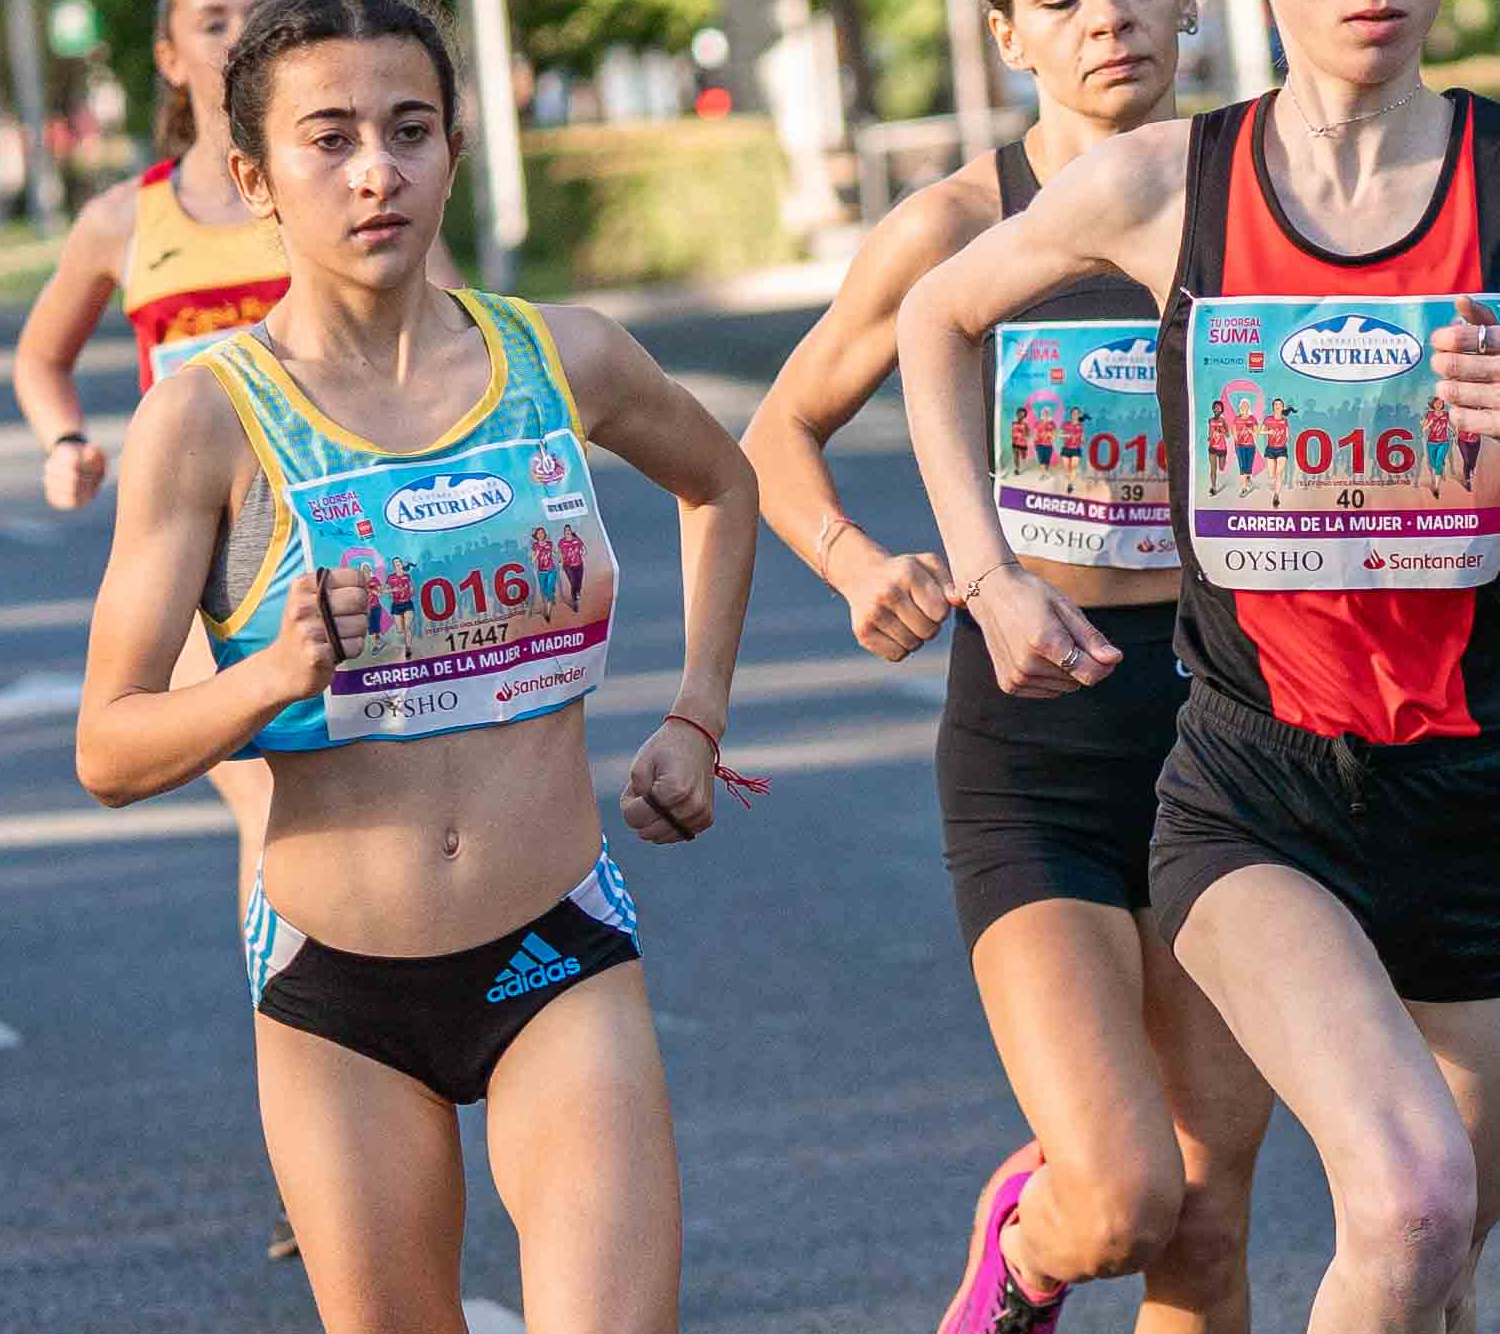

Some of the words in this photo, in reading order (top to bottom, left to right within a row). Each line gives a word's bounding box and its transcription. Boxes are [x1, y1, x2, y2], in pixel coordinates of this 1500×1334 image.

[1224, 317, 1261, 327] DORSAL
[1209, 328, 1260, 343] SUMA
[1291, 339, 1413, 364] ASTURIANA
[1295, 428, 1415, 475] 016
[1120, 484, 1144, 501] 39
[1336, 488, 1365, 508] 40
[312, 501, 363, 523] SUMA
[398, 489, 506, 524] ASTURIANA
[1025, 494, 1086, 517] CARRERA
[1088, 504, 1107, 520] DE
[1108, 507, 1125, 521] LA
[1227, 515, 1296, 532] CARRERA
[1300, 516, 1320, 532] DE
[1325, 515, 1344, 531] LA
[1350, 515, 1402, 531] MUJER
[1416, 514, 1479, 530] MADRID
[1021, 523, 1104, 551] OYSHO
[1224, 549, 1324, 572] OYSHO
[1389, 552, 1484, 570] Santander
[420, 563, 529, 622] 016
[445, 622, 509, 652] 17447
[362, 664, 430, 686] CARRERA
[433, 660, 453, 676] DE
[456, 657, 476, 674] LA
[480, 645, 520, 669] MUJER
[531, 632, 585, 655] MADRID
[513, 666, 587, 697] Santander
[486, 956, 581, 1003] adidas
